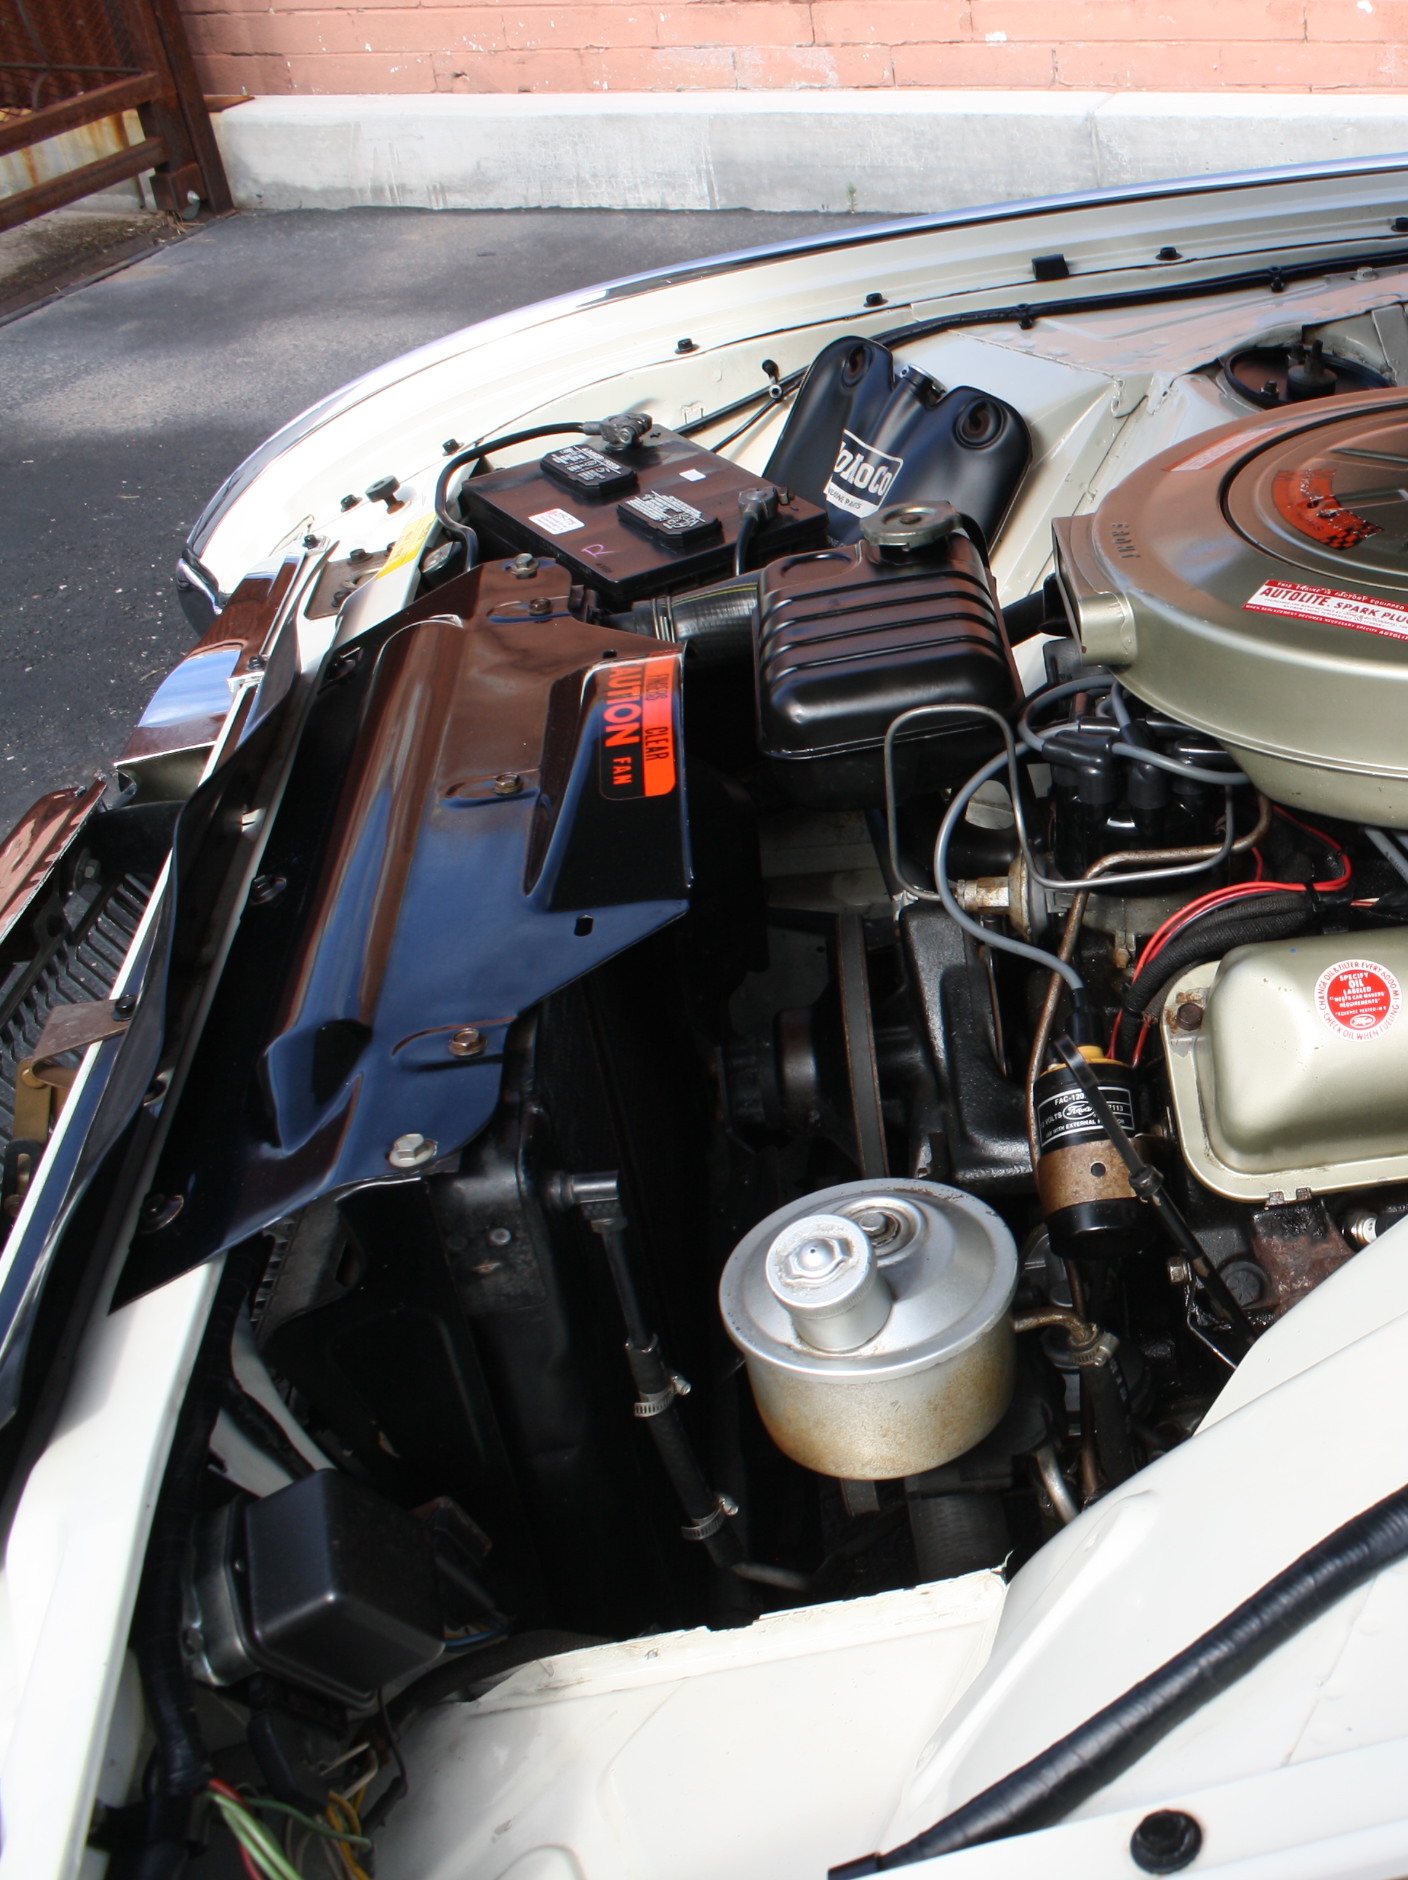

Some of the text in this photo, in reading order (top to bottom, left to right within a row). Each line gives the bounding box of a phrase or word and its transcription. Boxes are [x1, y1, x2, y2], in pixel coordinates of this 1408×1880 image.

[1259, 587, 1331, 606] AUTOLITE
[1334, 601, 1381, 617] SPARK
[603, 667, 643, 785] AUTION FAN
[644, 726, 670, 762] CLEAR
[1318, 980, 1328, 1011] CHANGE
[1323, 970, 1335, 981] OIL
[1361, 961, 1382, 973] EVERY
[1381, 971, 1398, 989] 6000
[1339, 972, 1369, 982] SPECIFY
[1348, 979, 1365, 989] OIL
[1323, 1004, 1400, 1040] CHECK OIL WHEN FUELING
[1054, 1092, 1087, 1106] FAC-120
[1045, 1111, 1062, 1125] VOLTS
[1065, 1119, 1096, 1130] EXTERNAL
